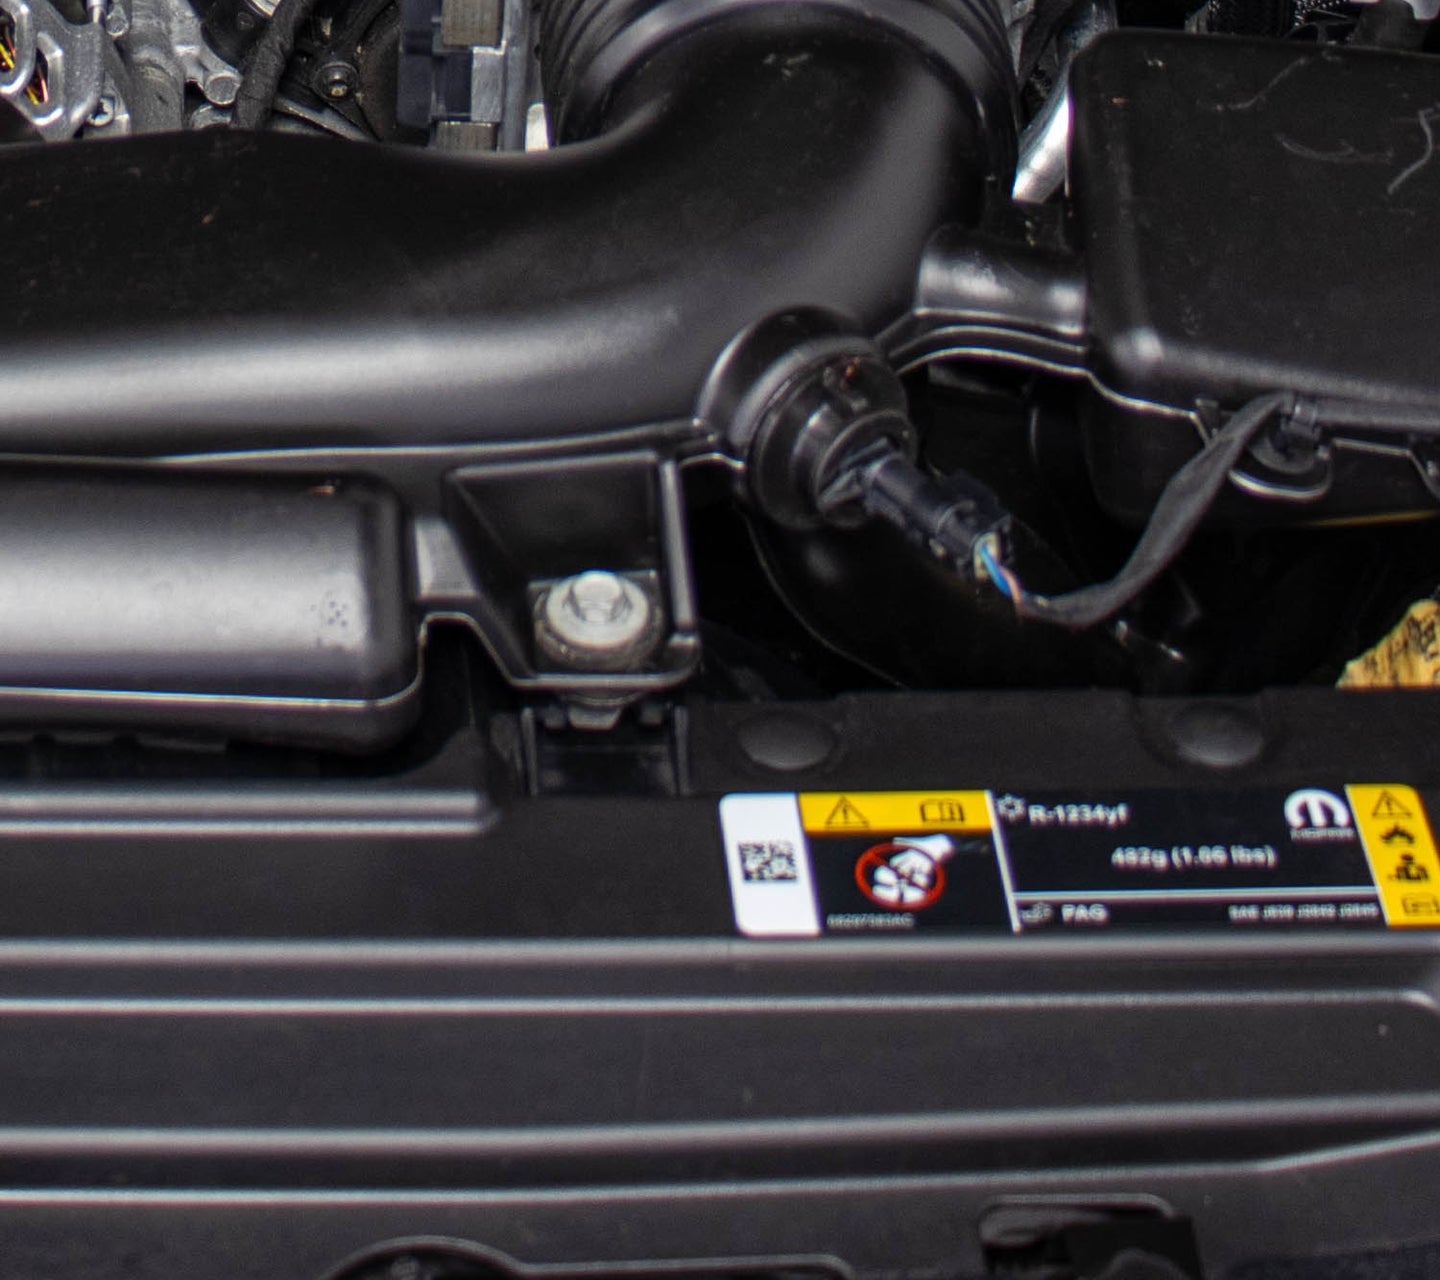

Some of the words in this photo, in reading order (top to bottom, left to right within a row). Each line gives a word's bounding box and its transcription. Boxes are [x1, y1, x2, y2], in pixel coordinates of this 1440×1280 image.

[1027, 803, 1130, 828] R-1234yf
[1230, 844, 1278, 870] lbs)
[1061, 903, 1109, 923] PAG
